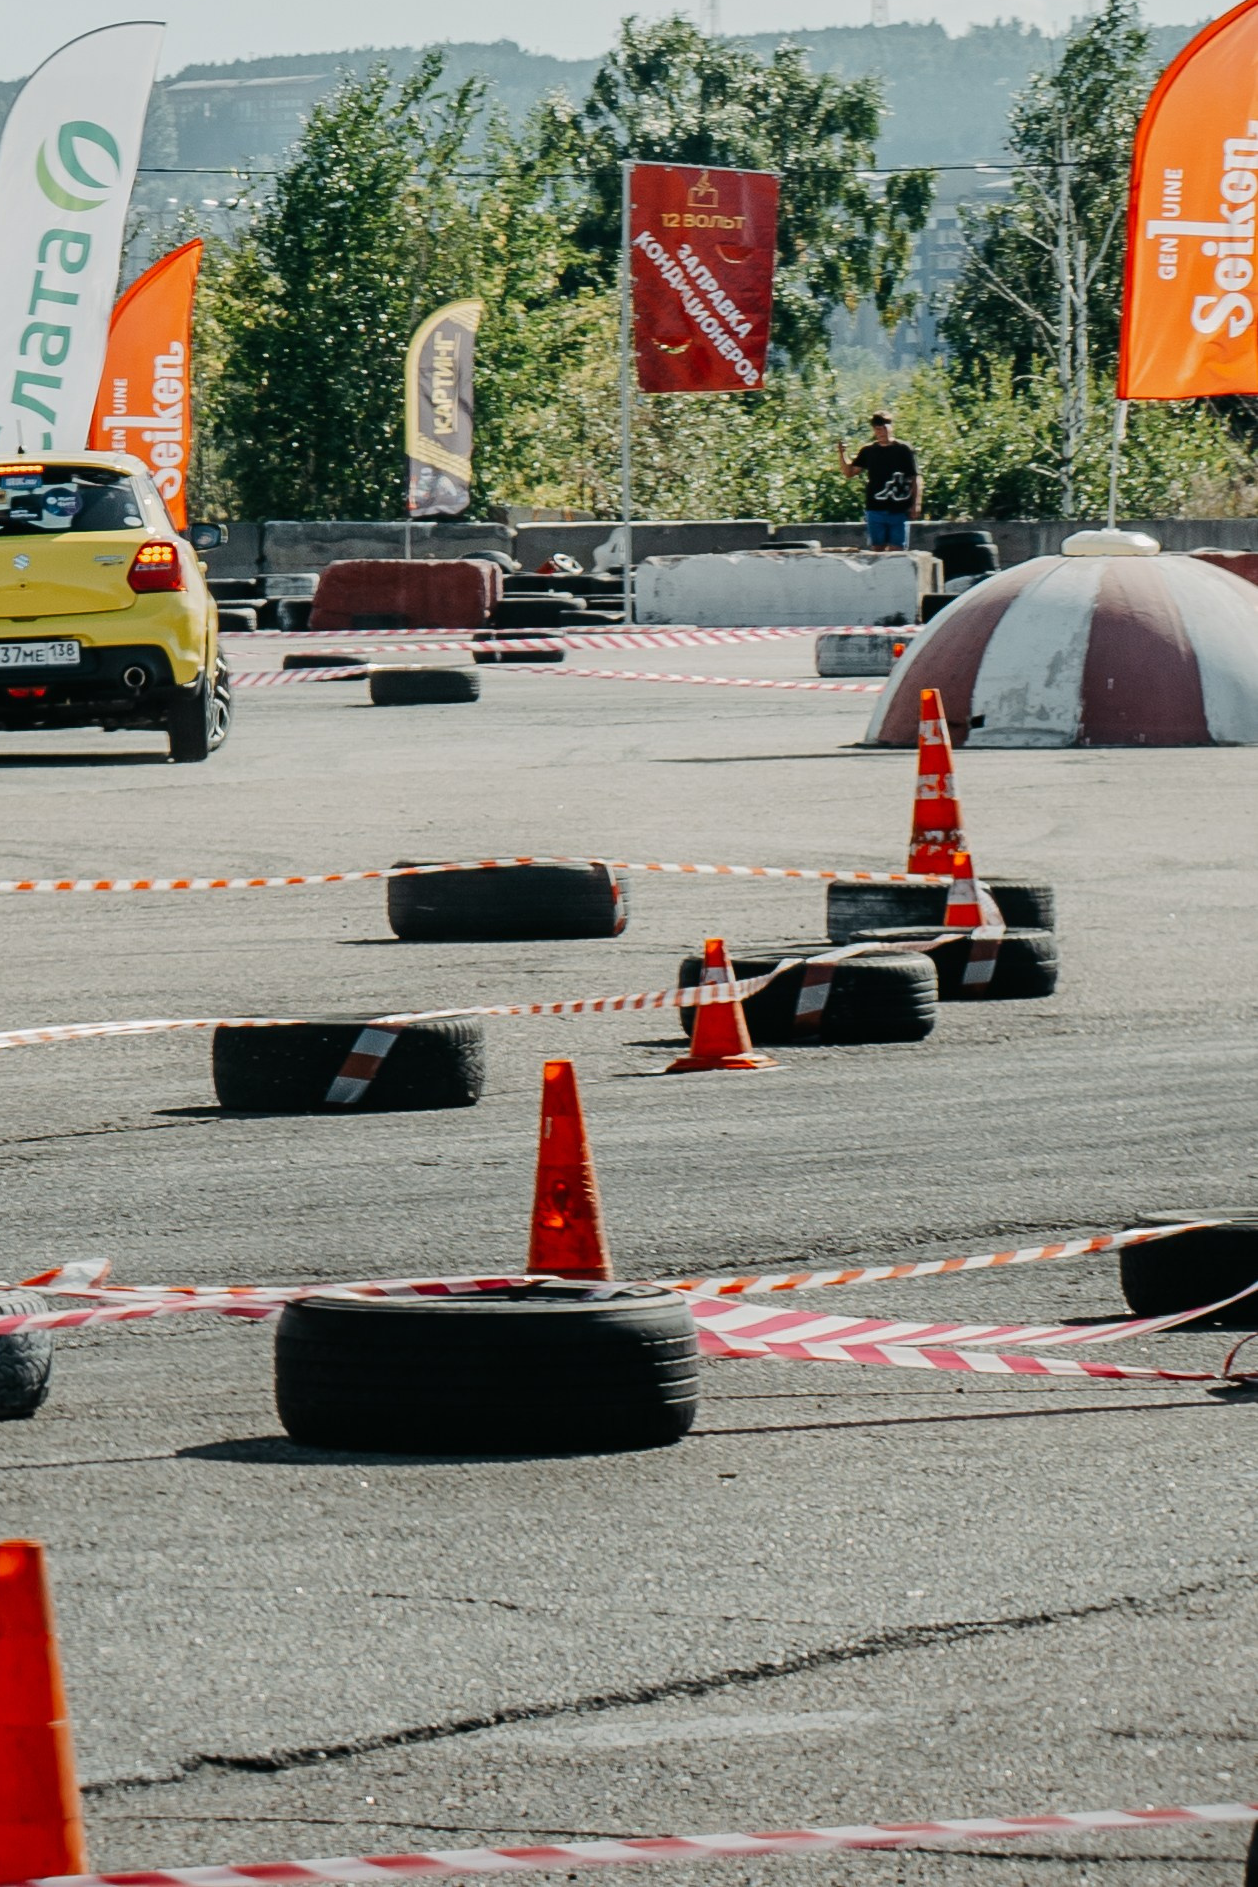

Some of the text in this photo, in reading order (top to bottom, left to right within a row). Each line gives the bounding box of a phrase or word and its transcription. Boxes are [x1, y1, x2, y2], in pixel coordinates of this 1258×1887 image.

[661, 213, 746, 230] 12 ВОЛЬТ
[1146, 119, 1258, 339] Seiken
[632, 230, 760, 386] КОНДИЦИОНЕРОВ
[676, 243, 753, 339] ЗАПРАВКА
[111, 378, 129, 454] ENUINE
[431, 331, 456, 435] КАРТИНГ
[49, 643, 76, 657] 138
